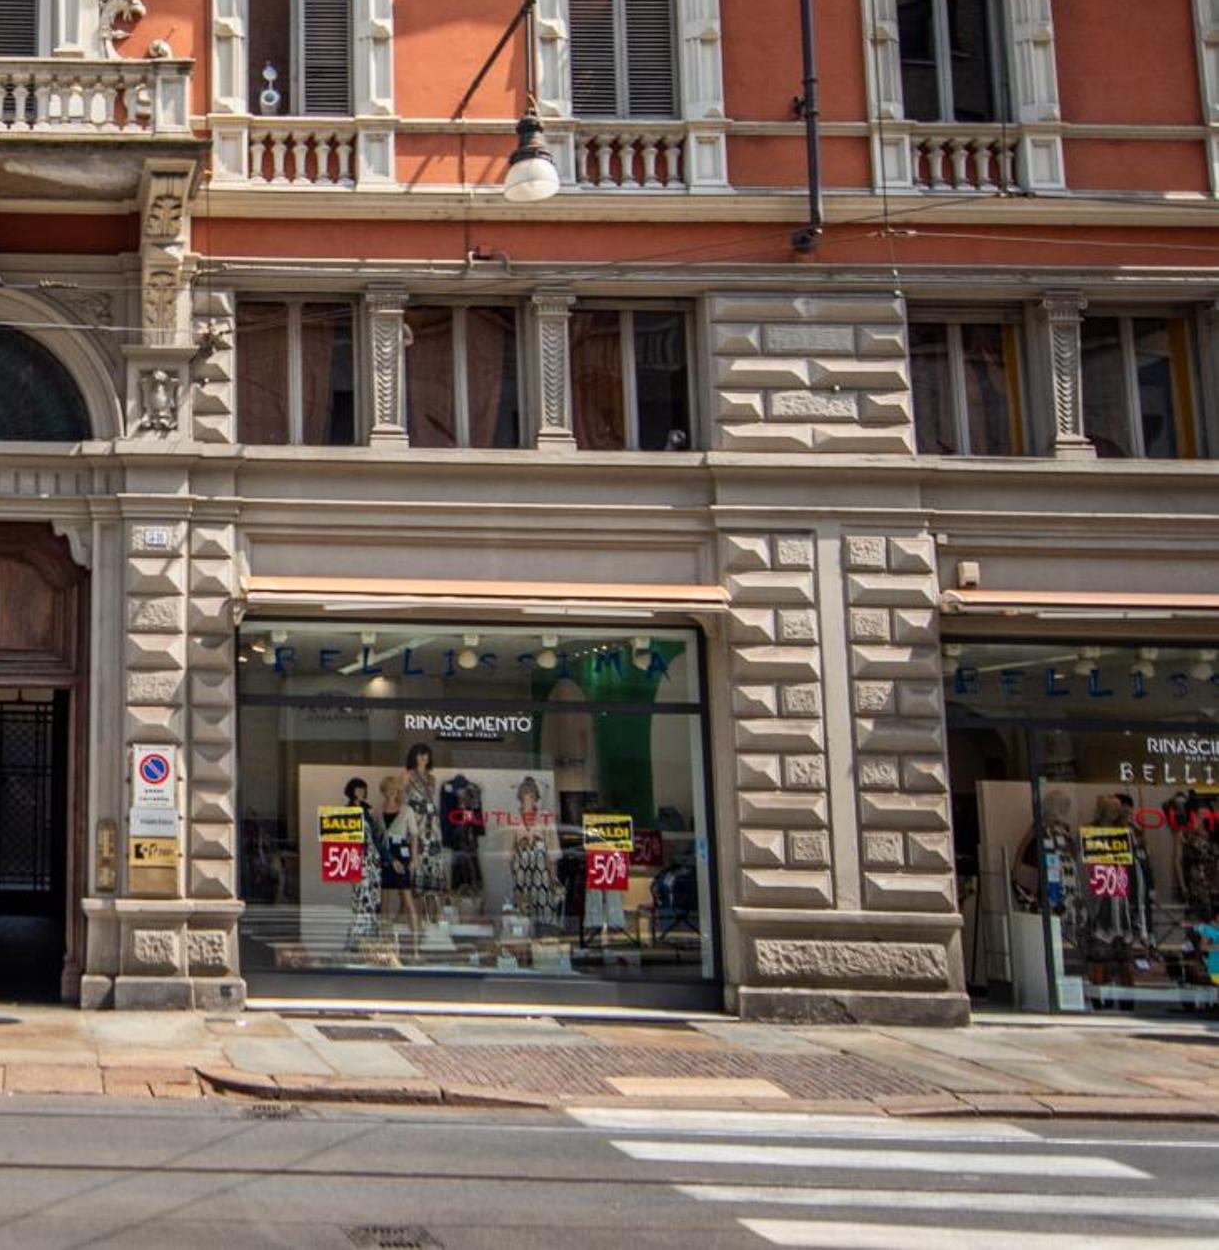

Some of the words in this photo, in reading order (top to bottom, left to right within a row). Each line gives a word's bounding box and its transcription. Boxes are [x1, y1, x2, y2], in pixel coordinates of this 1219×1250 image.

[275, 646, 670, 681] BELLISSIMA
[404, 714, 532, 733] RINASCIMENTO
[1147, 737, 1219, 755] RINASCI
[322, 818, 361, 830] SALDI
[448, 809, 553, 828] OUTLET
[323, 847, 361, 877] -50%
[589, 853, 627, 884] -50%
[1089, 864, 1128, 896] -50%
